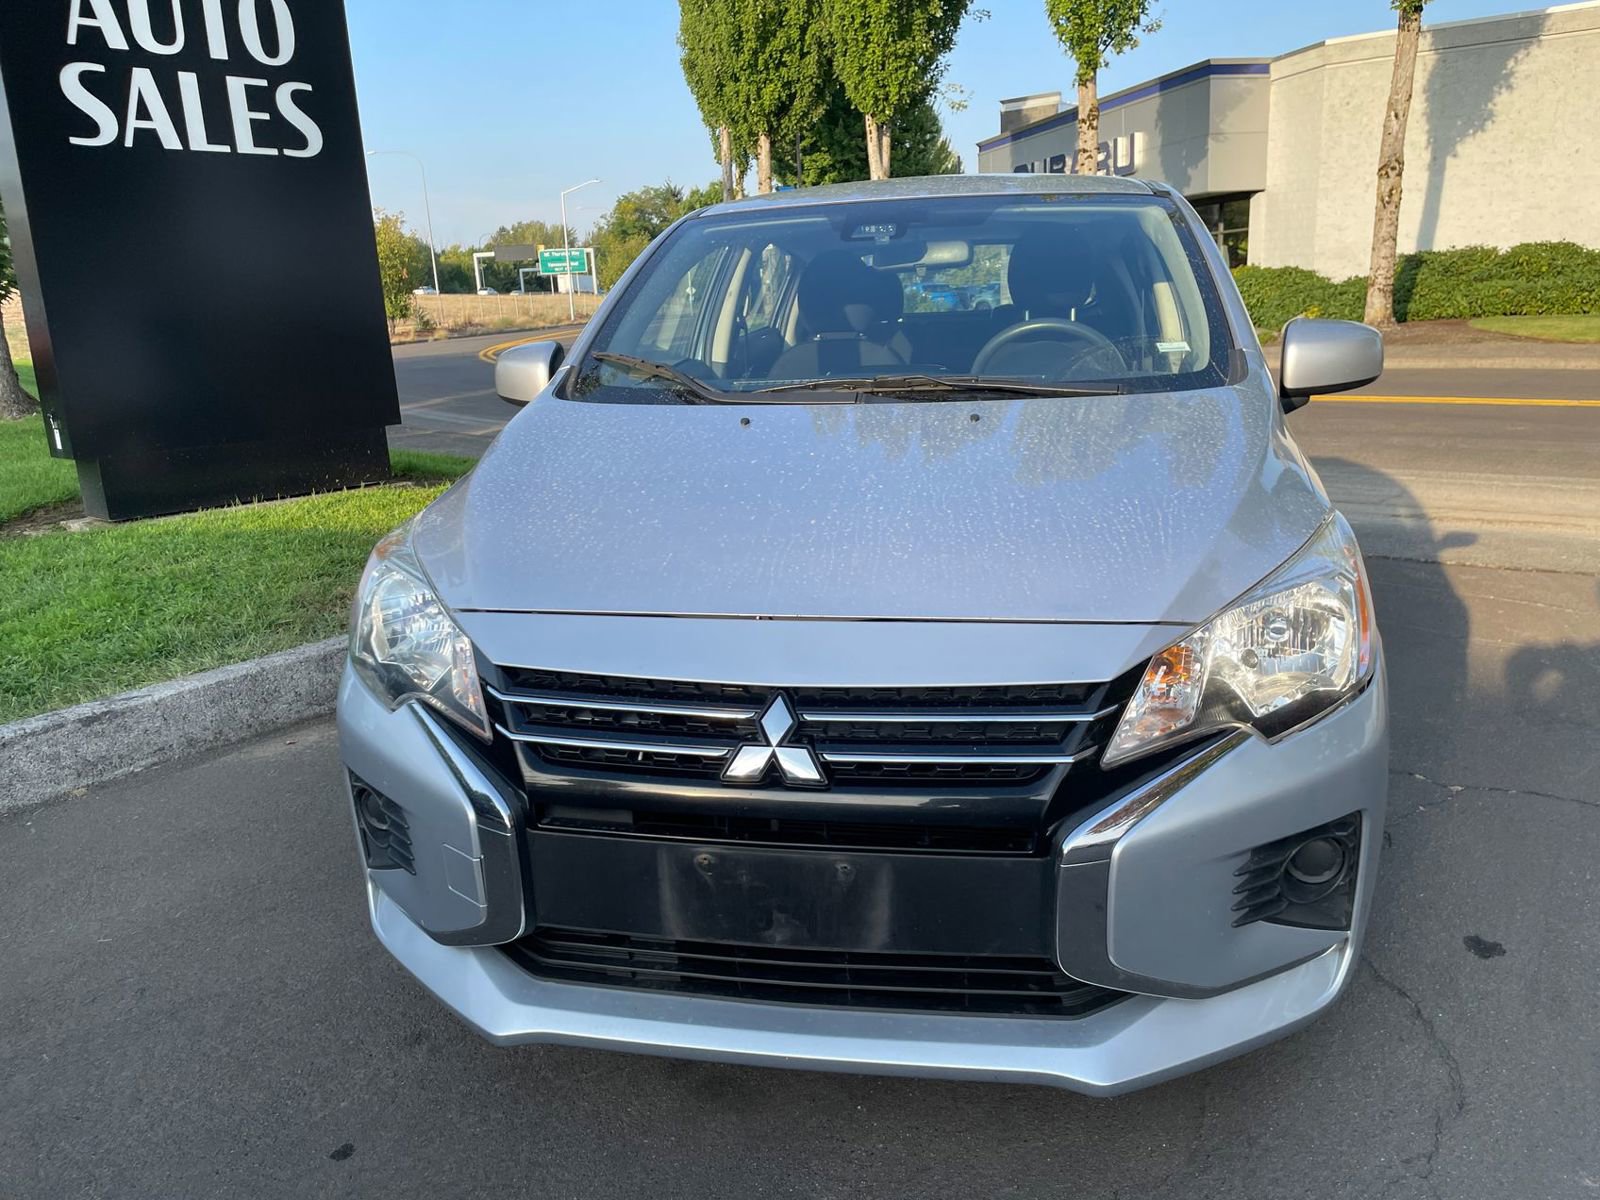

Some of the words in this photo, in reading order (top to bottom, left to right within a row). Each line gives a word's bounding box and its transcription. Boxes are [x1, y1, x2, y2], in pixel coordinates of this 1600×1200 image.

[66, 0, 296, 66] AUTO
[59, 61, 324, 158] SALES
[1013, 132, 1135, 176] BRU
